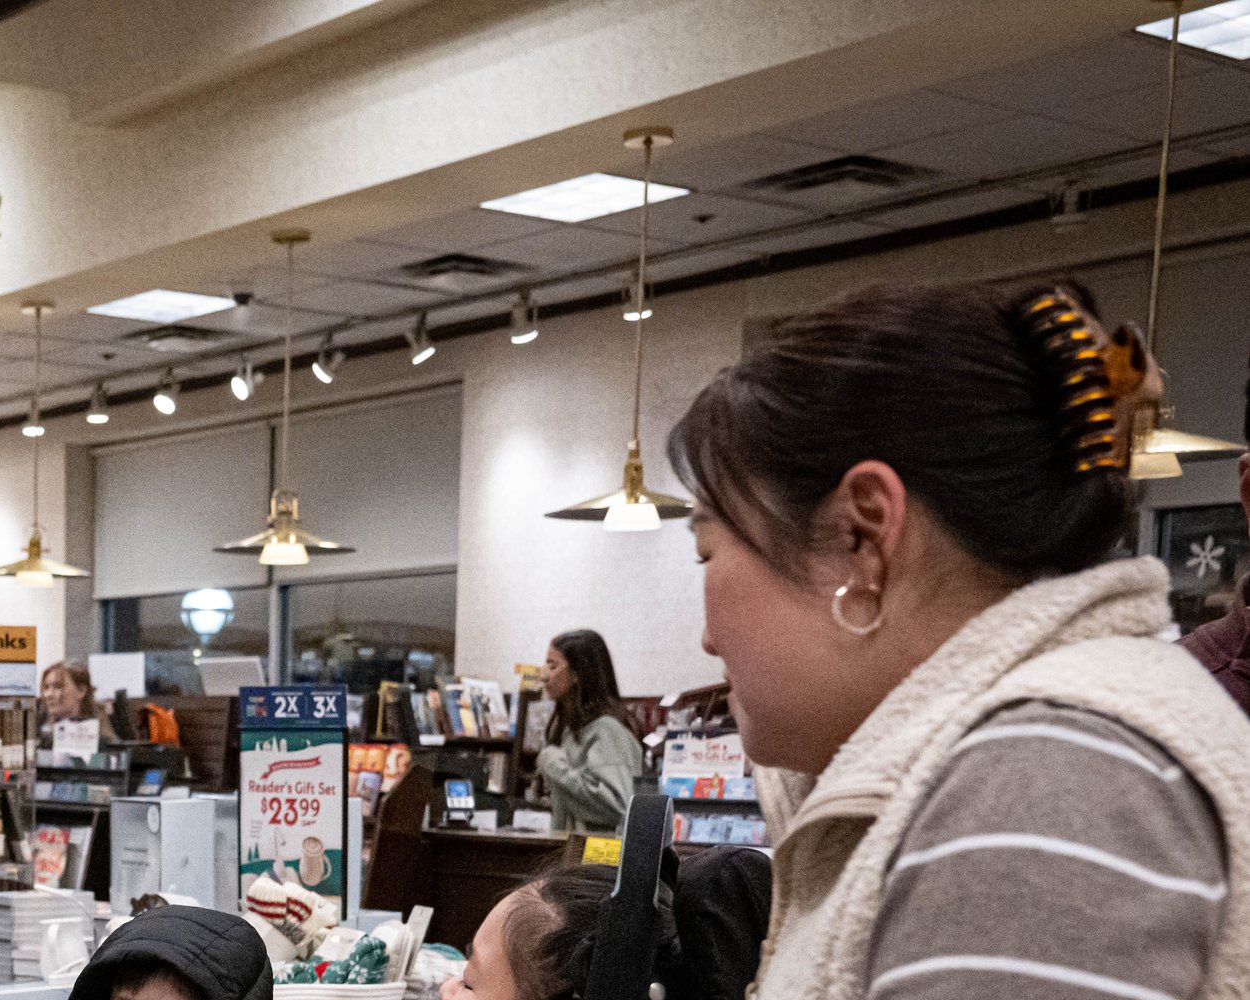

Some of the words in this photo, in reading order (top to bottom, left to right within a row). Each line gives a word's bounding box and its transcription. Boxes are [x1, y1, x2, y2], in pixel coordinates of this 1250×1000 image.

[248, 780, 293, 794] Reader's
[295, 781, 315, 795] Gift
[318, 782, 336, 795] Set
